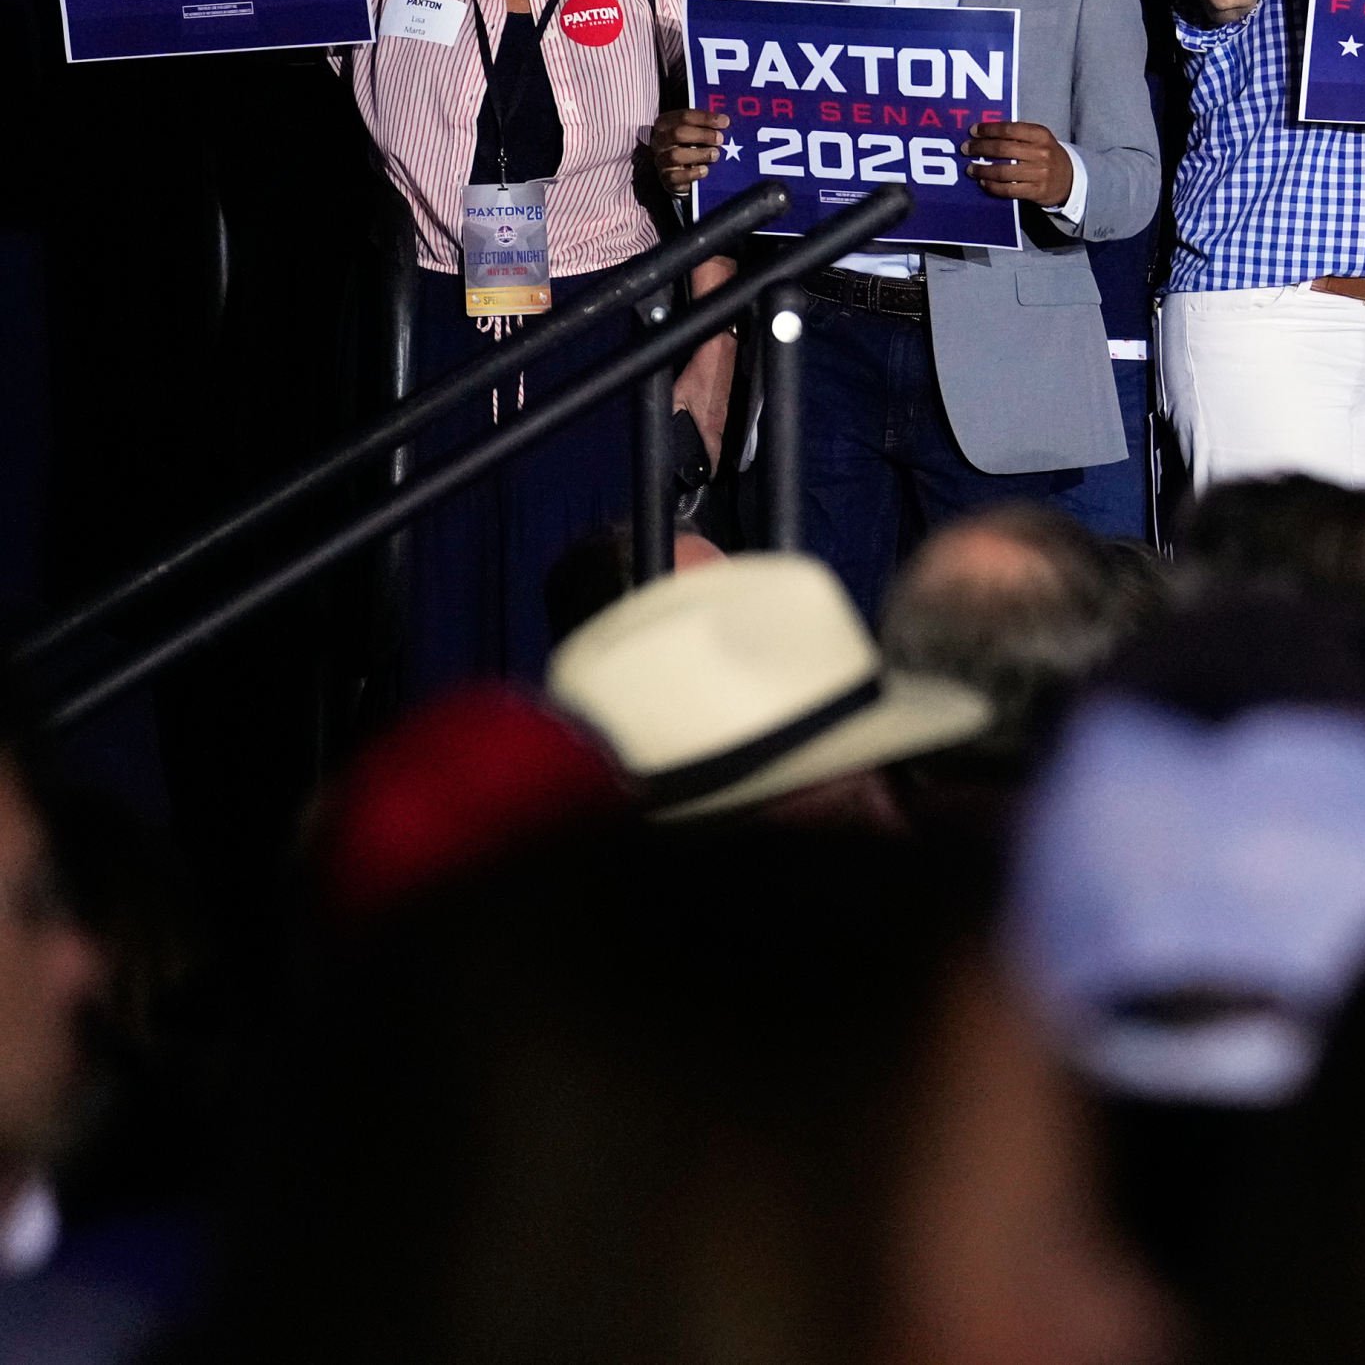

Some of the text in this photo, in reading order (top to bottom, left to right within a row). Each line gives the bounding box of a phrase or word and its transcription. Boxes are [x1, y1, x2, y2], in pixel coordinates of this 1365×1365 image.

[563, 6, 619, 27] PAXTON
[698, 37, 1004, 101] PAXTON
[708, 94, 795, 119] FOR
[756, 126, 959, 186] 2026
[467, 205, 543, 221] PAXTON 26
[516, 249, 545, 264] NIGHT
